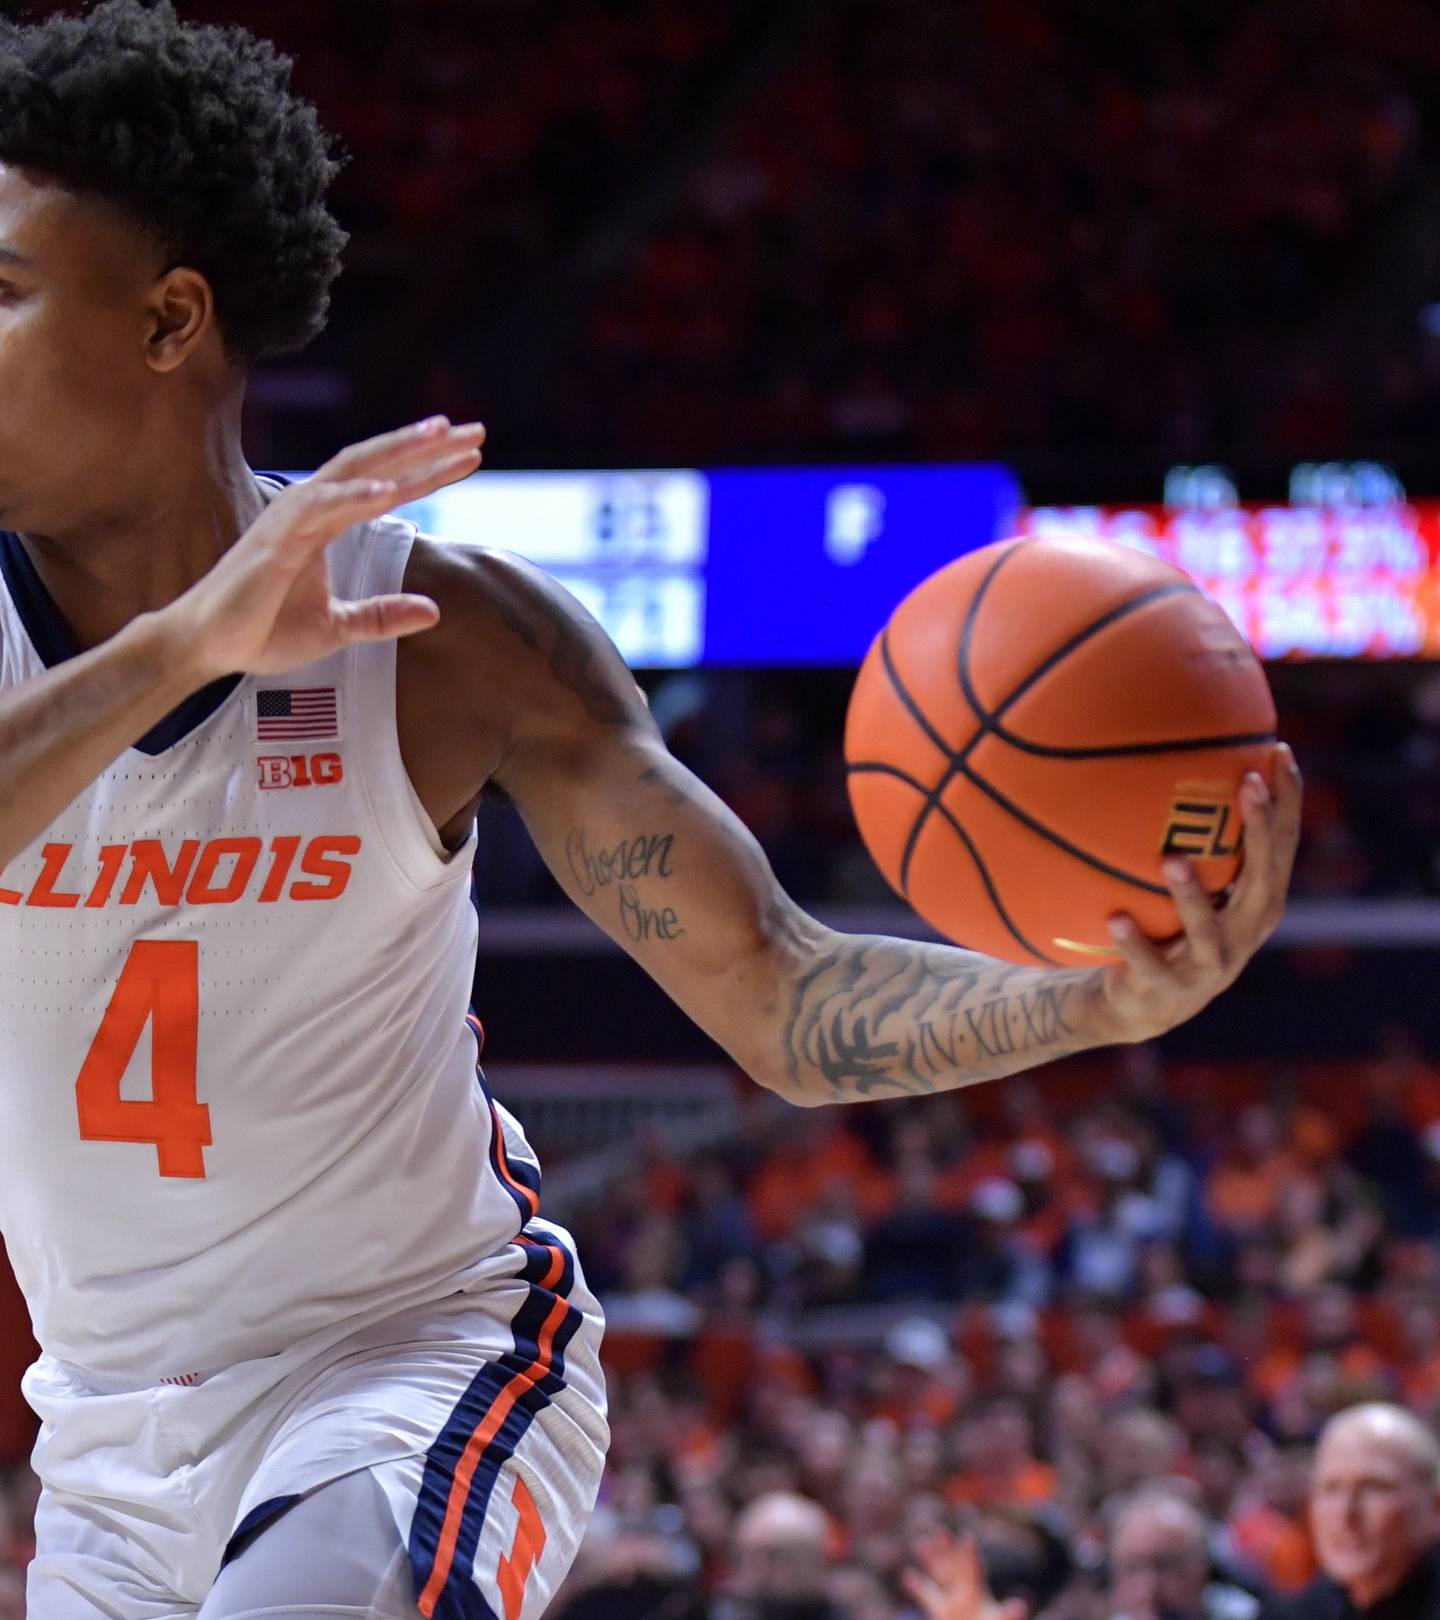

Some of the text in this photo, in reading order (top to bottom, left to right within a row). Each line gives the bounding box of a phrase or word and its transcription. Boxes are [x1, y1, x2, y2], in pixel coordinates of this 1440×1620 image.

[566, 827, 675, 897] Chosen
[618, 882, 687, 943] One
[75, 939, 213, 1180] 4
